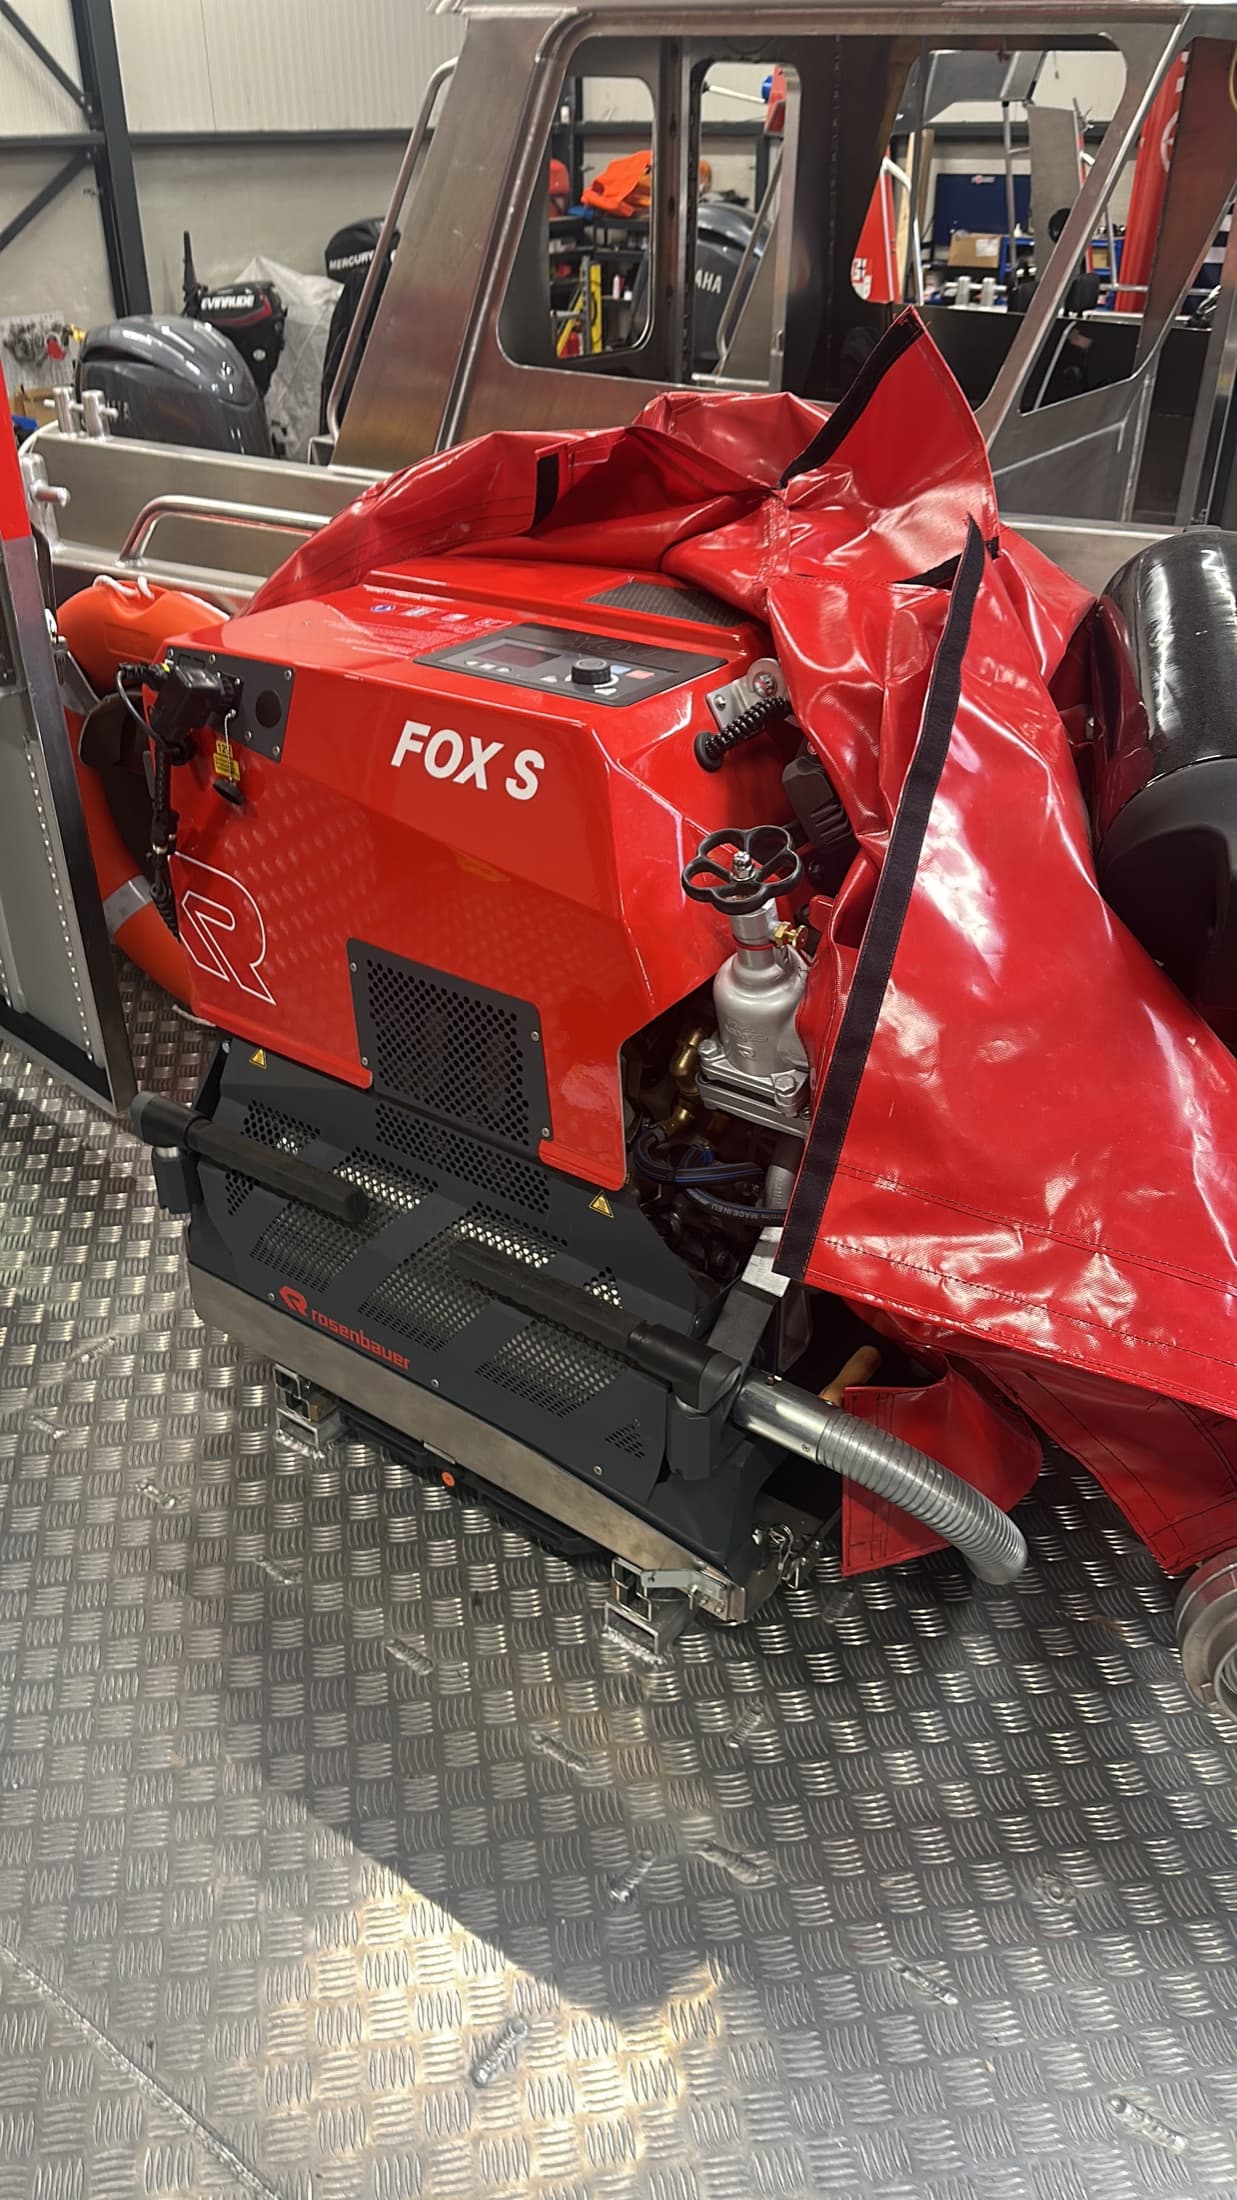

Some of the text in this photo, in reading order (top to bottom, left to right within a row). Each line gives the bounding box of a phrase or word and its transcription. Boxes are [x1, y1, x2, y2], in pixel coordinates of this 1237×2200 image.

[329, 250, 375, 270] MERCURY
[201, 294, 255, 311] EVINRUDE
[390, 719, 545, 800] FOX S
[733, 1210, 758, 1220] MADE
[311, 1309, 411, 1370] rosenbauer
